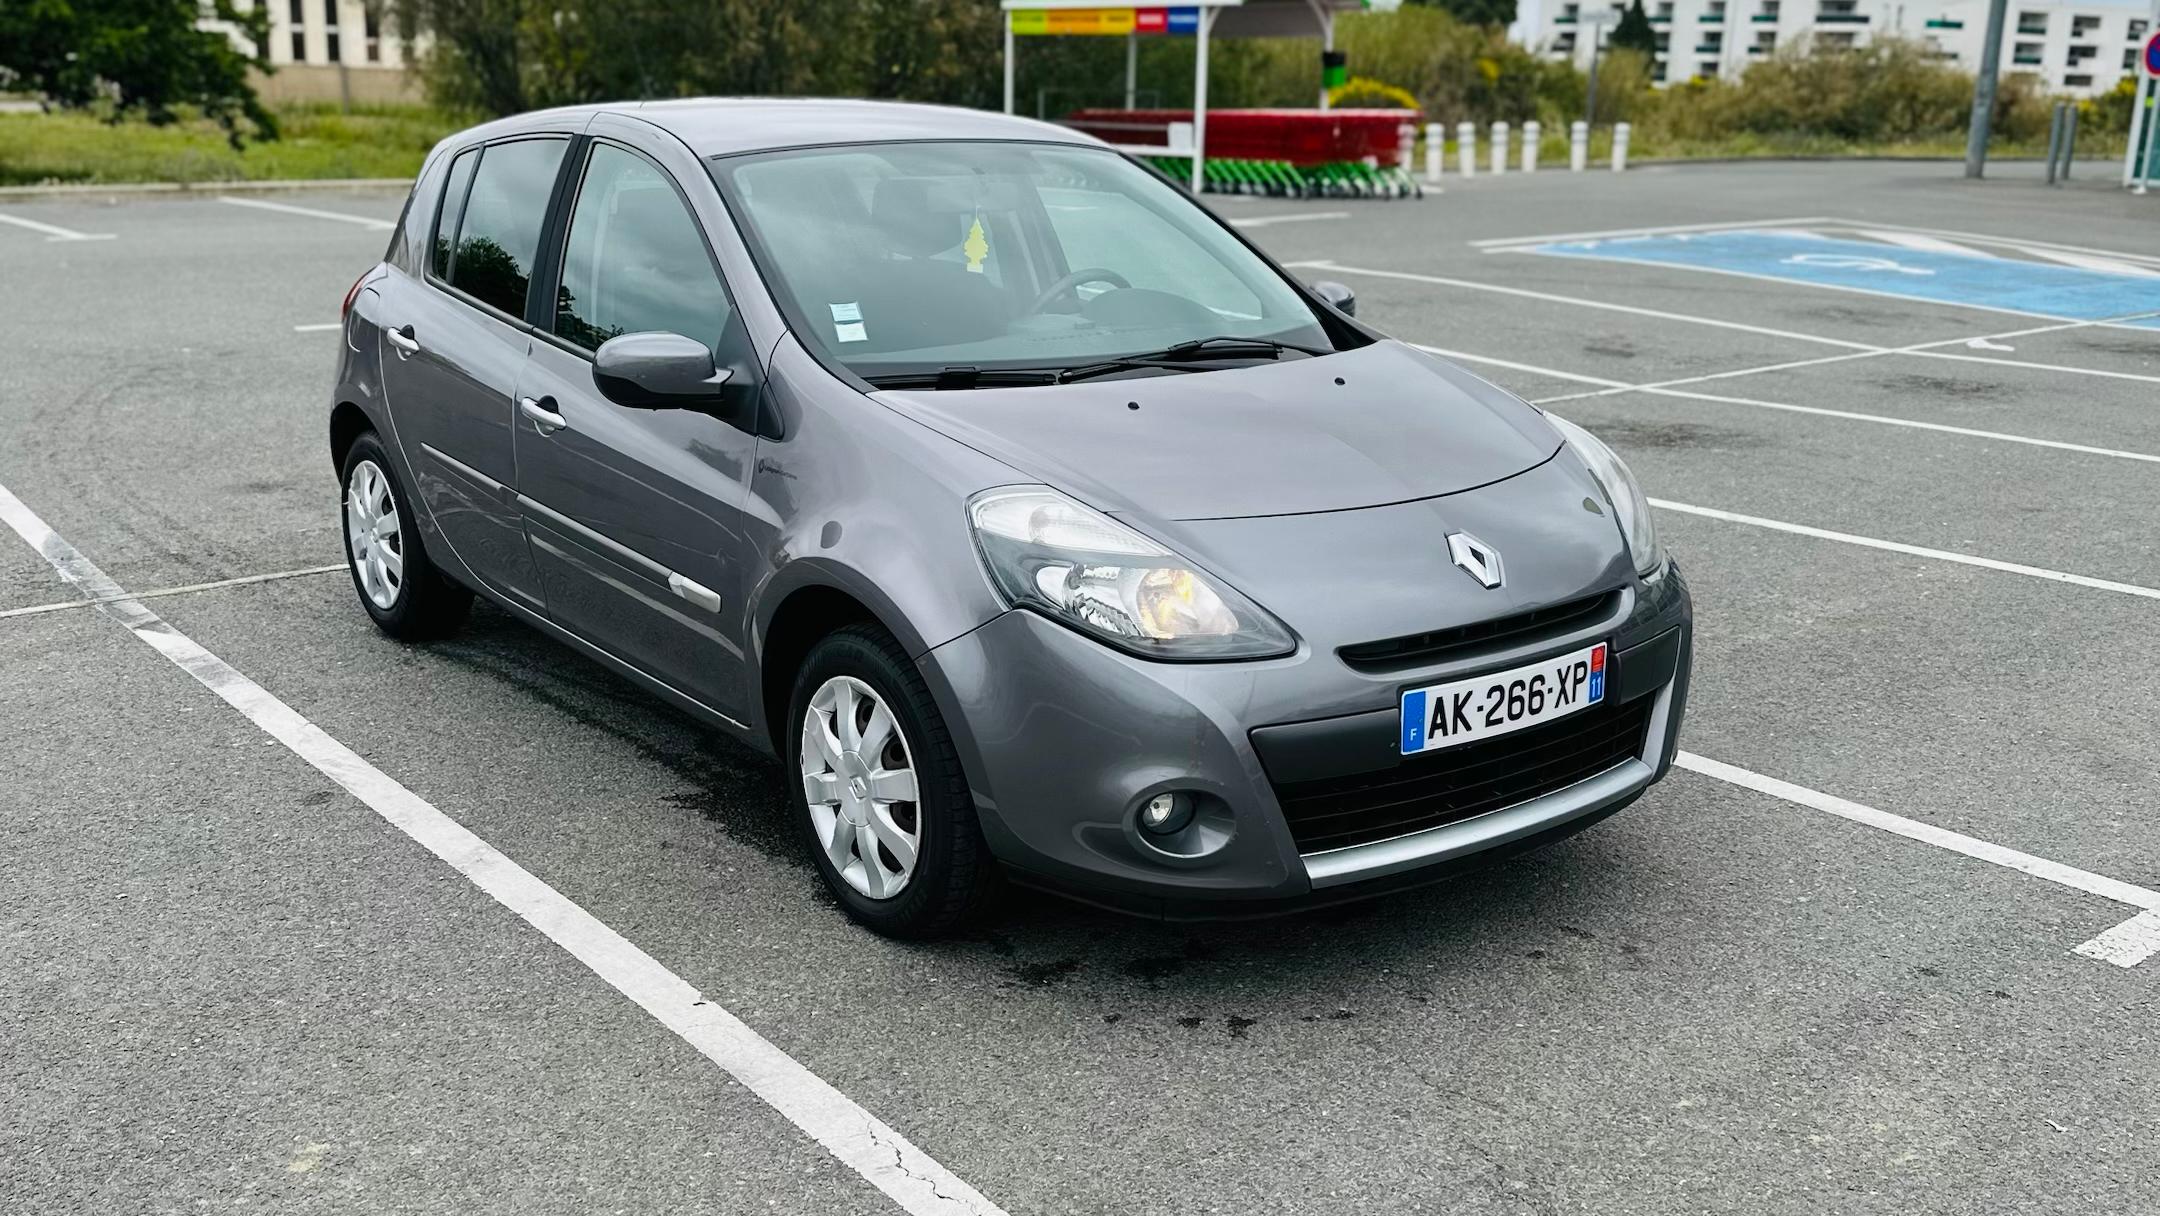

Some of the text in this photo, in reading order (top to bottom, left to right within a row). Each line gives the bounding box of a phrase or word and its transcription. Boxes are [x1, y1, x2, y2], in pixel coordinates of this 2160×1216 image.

[1591, 676, 1601, 697] 11
[1428, 661, 1587, 739] AK-266-XP
[1410, 728, 1417, 741] F
